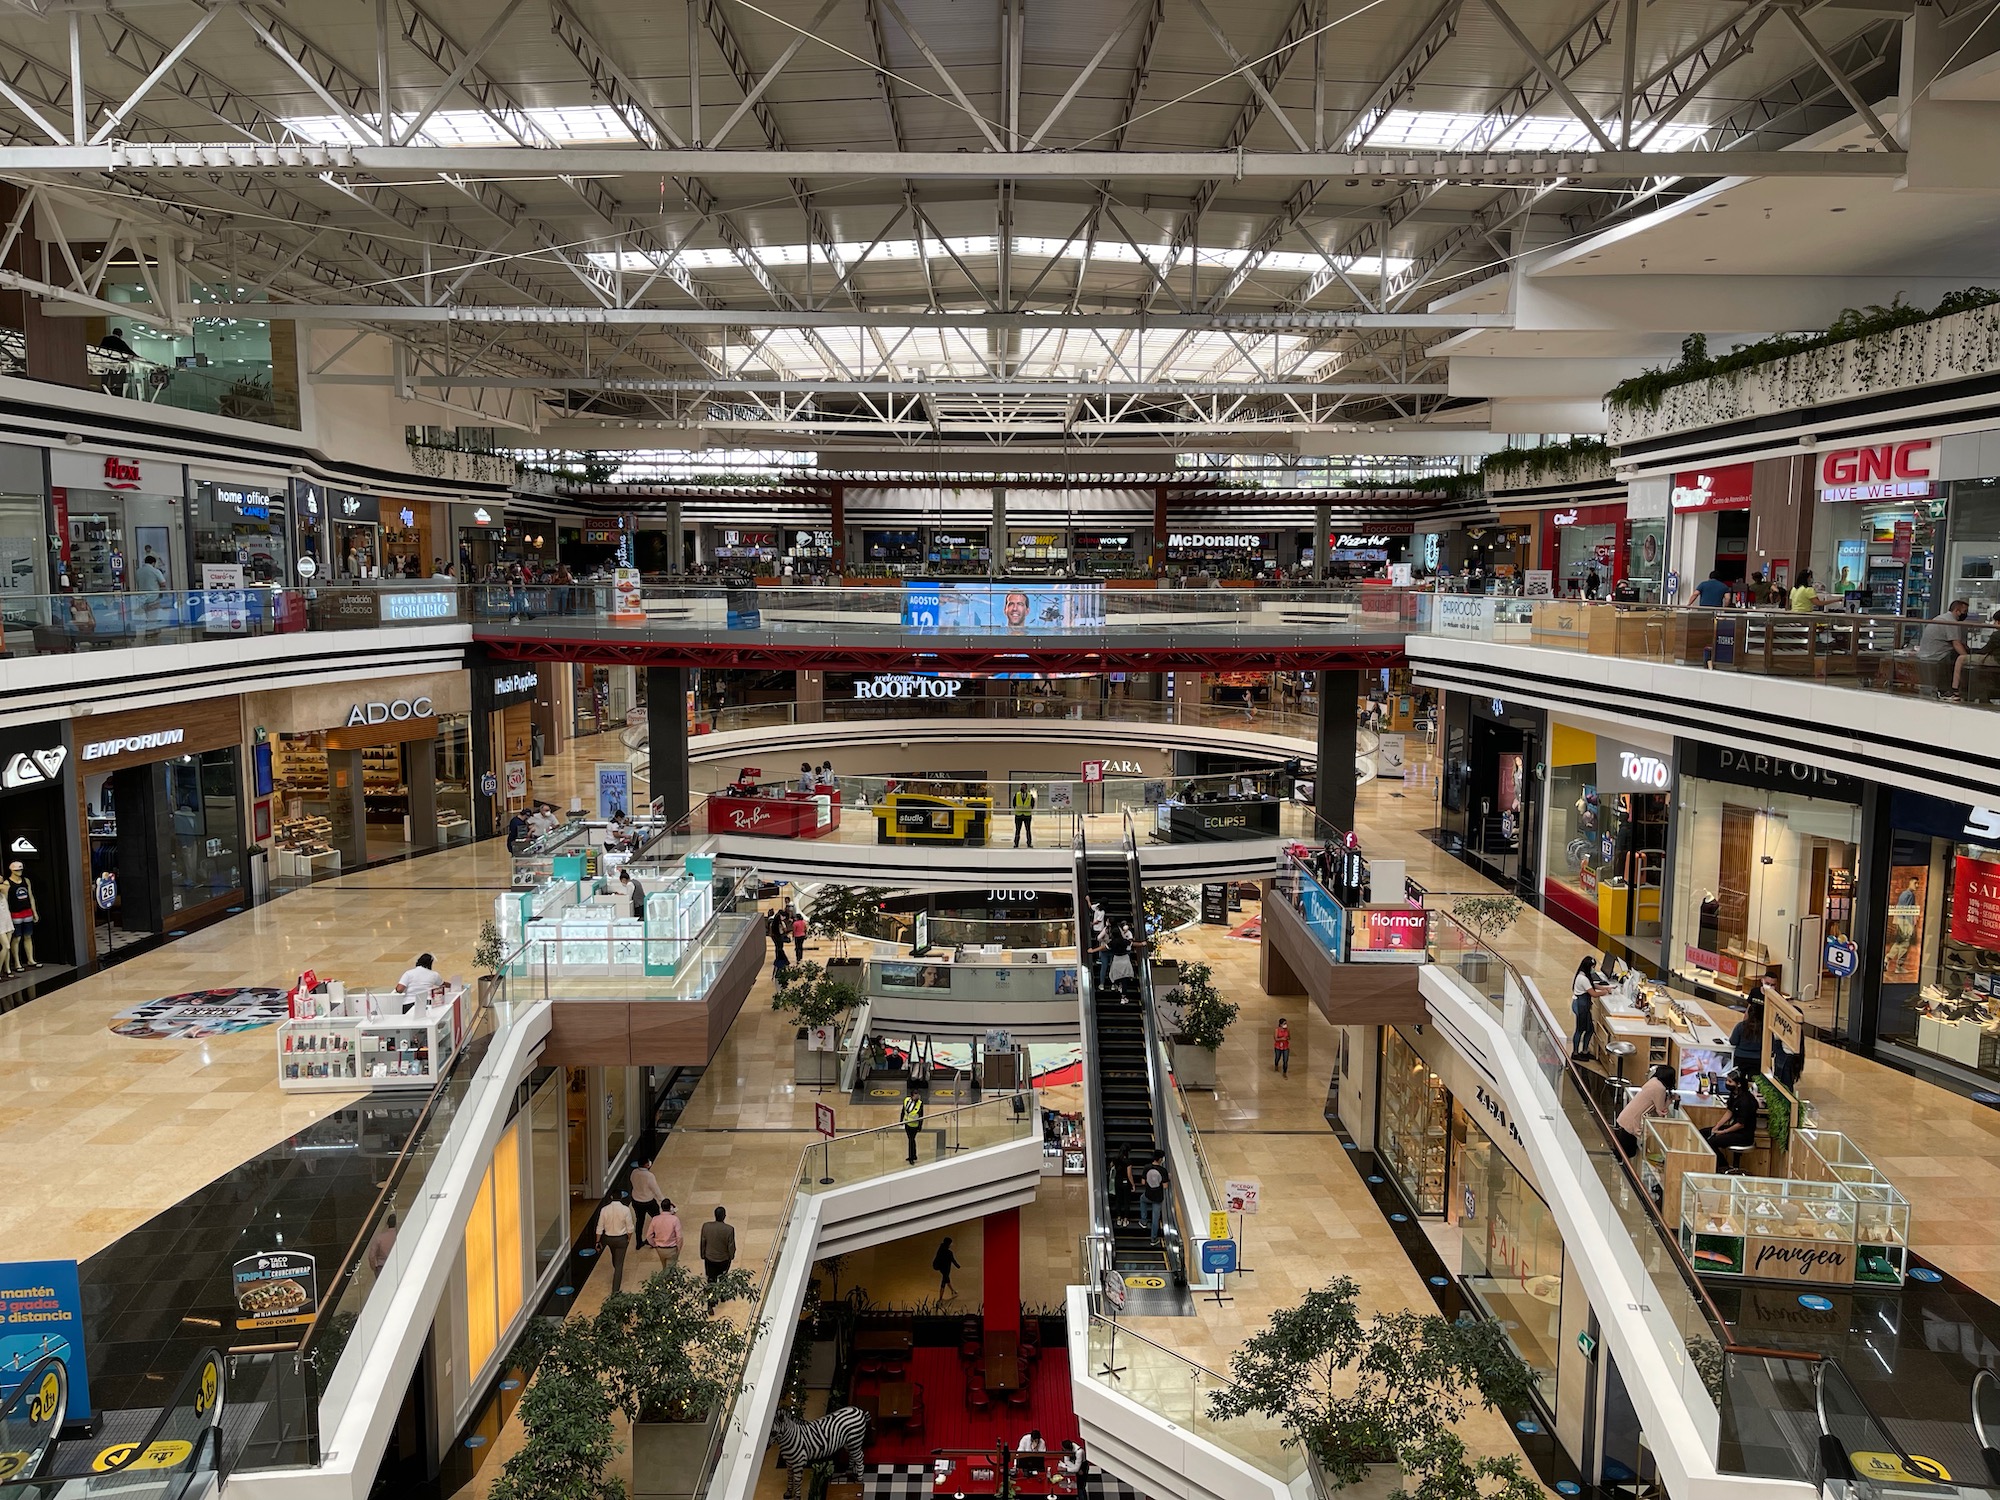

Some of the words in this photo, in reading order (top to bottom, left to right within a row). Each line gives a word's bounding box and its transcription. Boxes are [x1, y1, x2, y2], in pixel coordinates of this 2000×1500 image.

[1823, 441, 1932, 485] GNC
[218, 488, 242, 503] home
[247, 491, 270, 506] office
[1671, 480, 1712, 508] Claro
[1712, 497, 1724, 505] Centro
[1729, 495, 1746, 503] Atención
[1823, 487, 1857, 501] LIVE
[587, 520, 610, 529] Food
[1553, 511, 1577, 525] Claro
[1366, 525, 1388, 533] Food
[1389, 525, 1412, 533] Court
[587, 531, 615, 543] park
[742, 533, 773, 545] KFC
[1018, 535, 1057, 545] SUBWAY
[1168, 534, 1260, 547] McDonald's
[1337, 535, 1367, 547] Pizza
[1367, 535, 1390, 546] Hut
[240, 552, 247, 560] 18
[1839, 546, 1865, 554] FOCUS
[113, 558, 122, 567] 19
[347, 594, 372, 604] tradición
[909, 596, 939, 606] AGOSTO
[340, 605, 372, 614] deliciosa
[496, 677, 513, 695] Hush
[514, 671, 538, 693] Puppies
[874, 673, 915, 683] welcome
[853, 679, 962, 698] ROOFTOP
[82, 728, 184, 760] EMPORIUM
[1101, 759, 1143, 774] ZARA
[1620, 751, 1669, 788] TOTTO
[486, 781, 495, 789] 59
[601, 773, 626, 785] GÁNATE
[899, 814, 924, 822] studio
[1503, 820, 1511, 829] 12
[1346, 833, 1353, 847] f
[1602, 842, 1610, 854] 13
[1351, 855, 1360, 887] flormar
[103, 885, 114, 898] 26
[1311, 891, 1336, 938] flormar
[1371, 913, 1425, 927] flormar
[1688, 949, 1716, 967] REBAJAS
[1834, 952, 1845, 963] 8
[1773, 1010, 1794, 1037] pangea
[1476, 1085, 1506, 1127] ZARA
[1490, 1219, 1530, 1294] SALE
[1755, 1243, 1847, 1275] pangea
[236, 1270, 272, 1283] TRIPLE
[271, 1266, 311, 1278] CRUNCHYWRAP
[1, 1286, 55, 1299] mantén
[0, 1300, 7, 1311] 3
[9, 1299, 60, 1312] gradas
[8, 1310, 72, 1323] distancia
